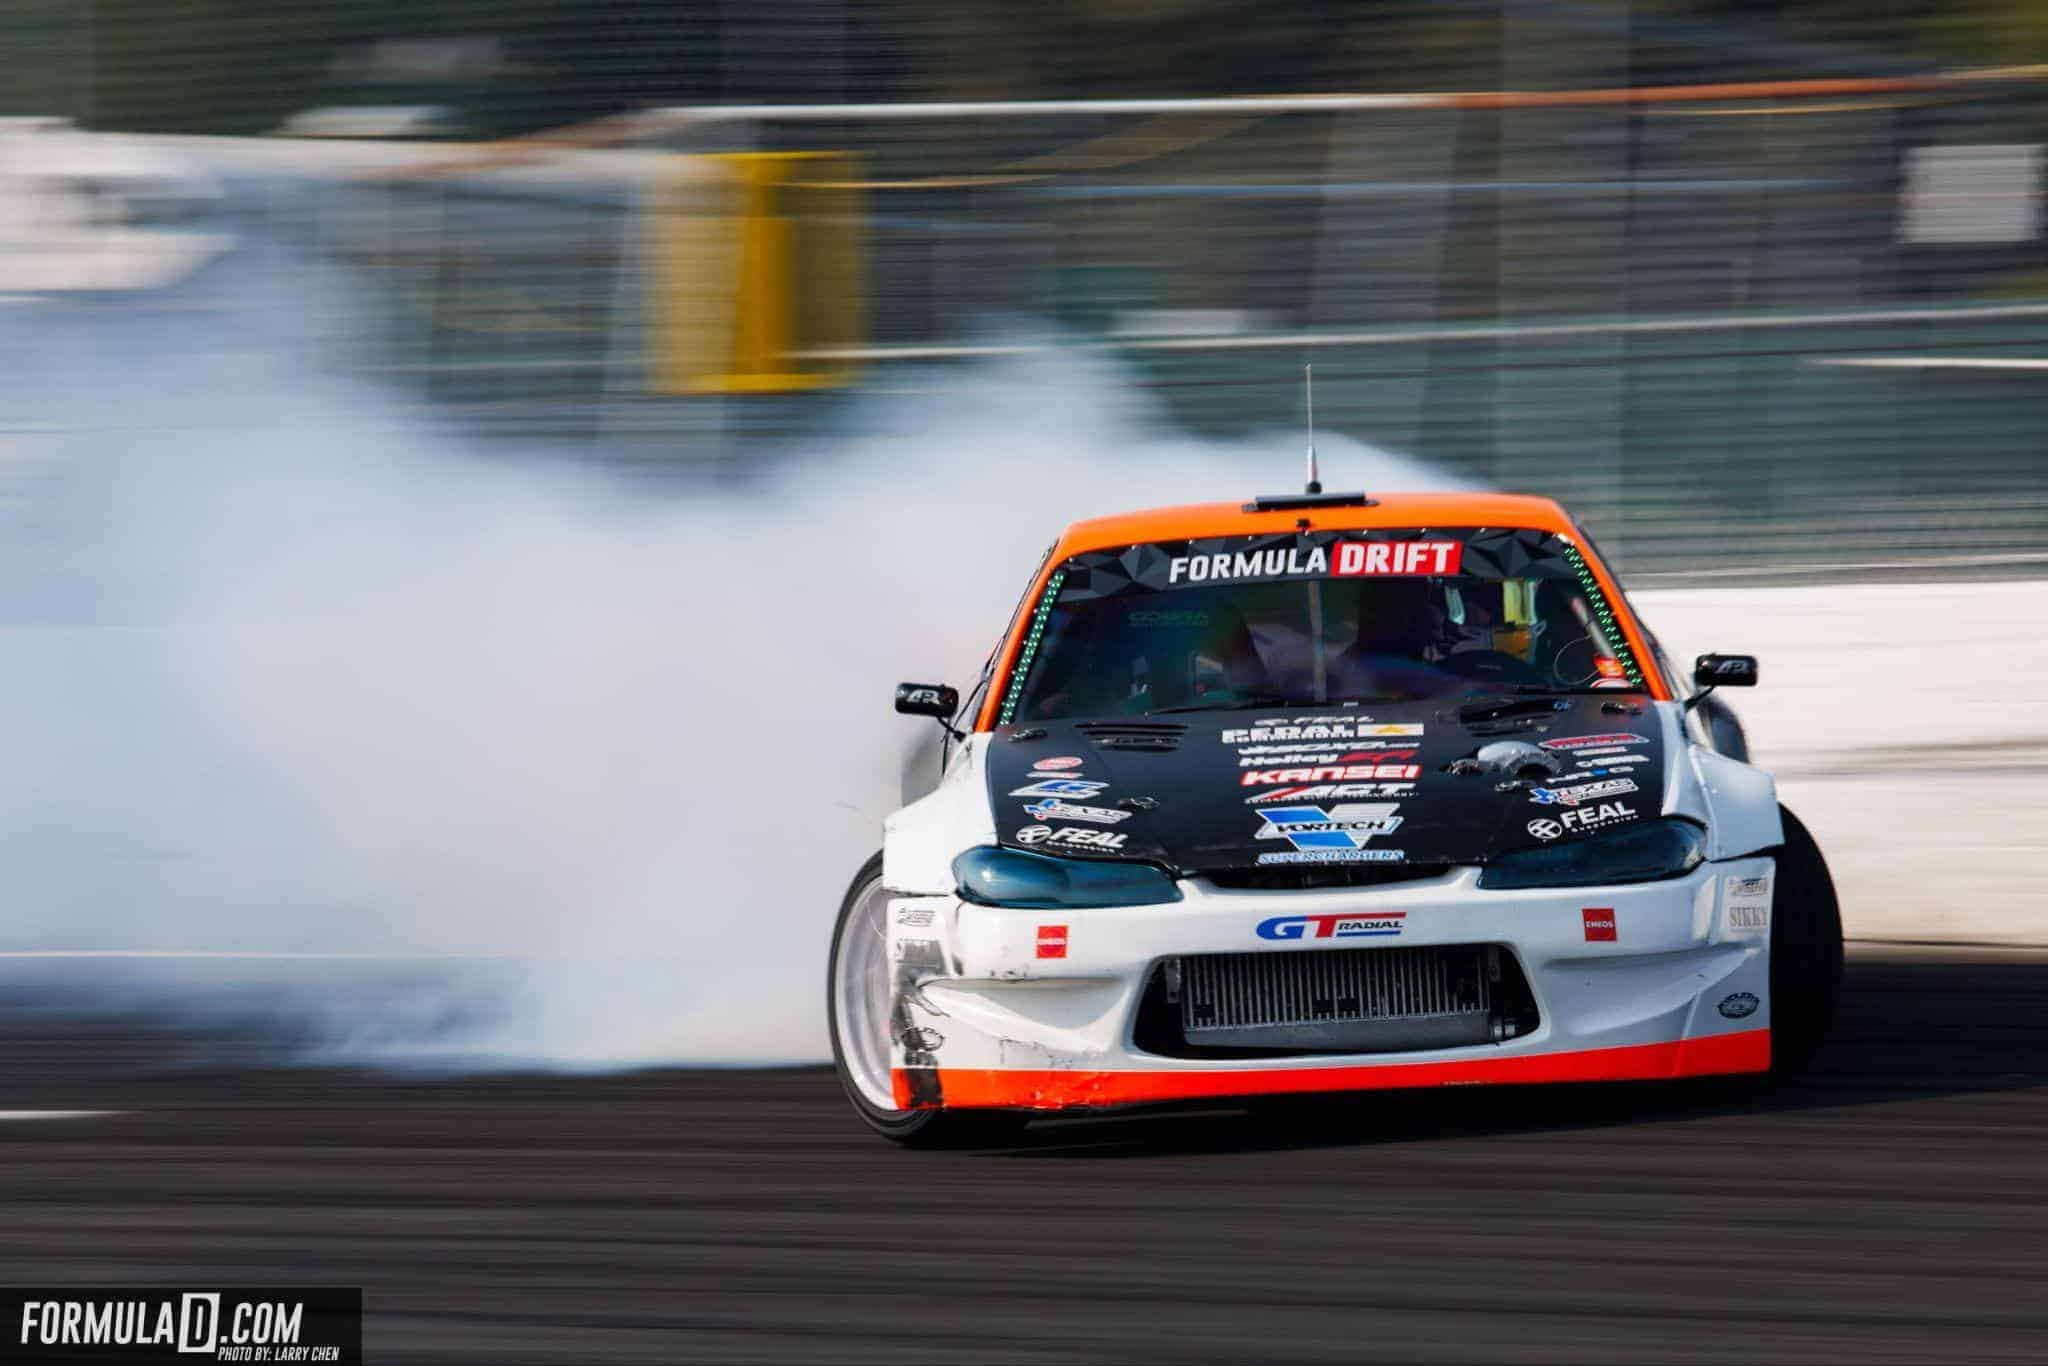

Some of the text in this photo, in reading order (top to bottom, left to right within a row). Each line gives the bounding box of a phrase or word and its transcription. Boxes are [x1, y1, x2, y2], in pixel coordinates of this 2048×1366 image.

[1169, 542, 1456, 583] FORMULA DRIFT
[1240, 764, 1422, 786] KANSEI
[1560, 801, 1636, 828] FEAL
[1050, 827, 1129, 849] FEAL
[1277, 821, 1386, 833] VORTECH
[1256, 913, 1404, 940] GT RADIAL
